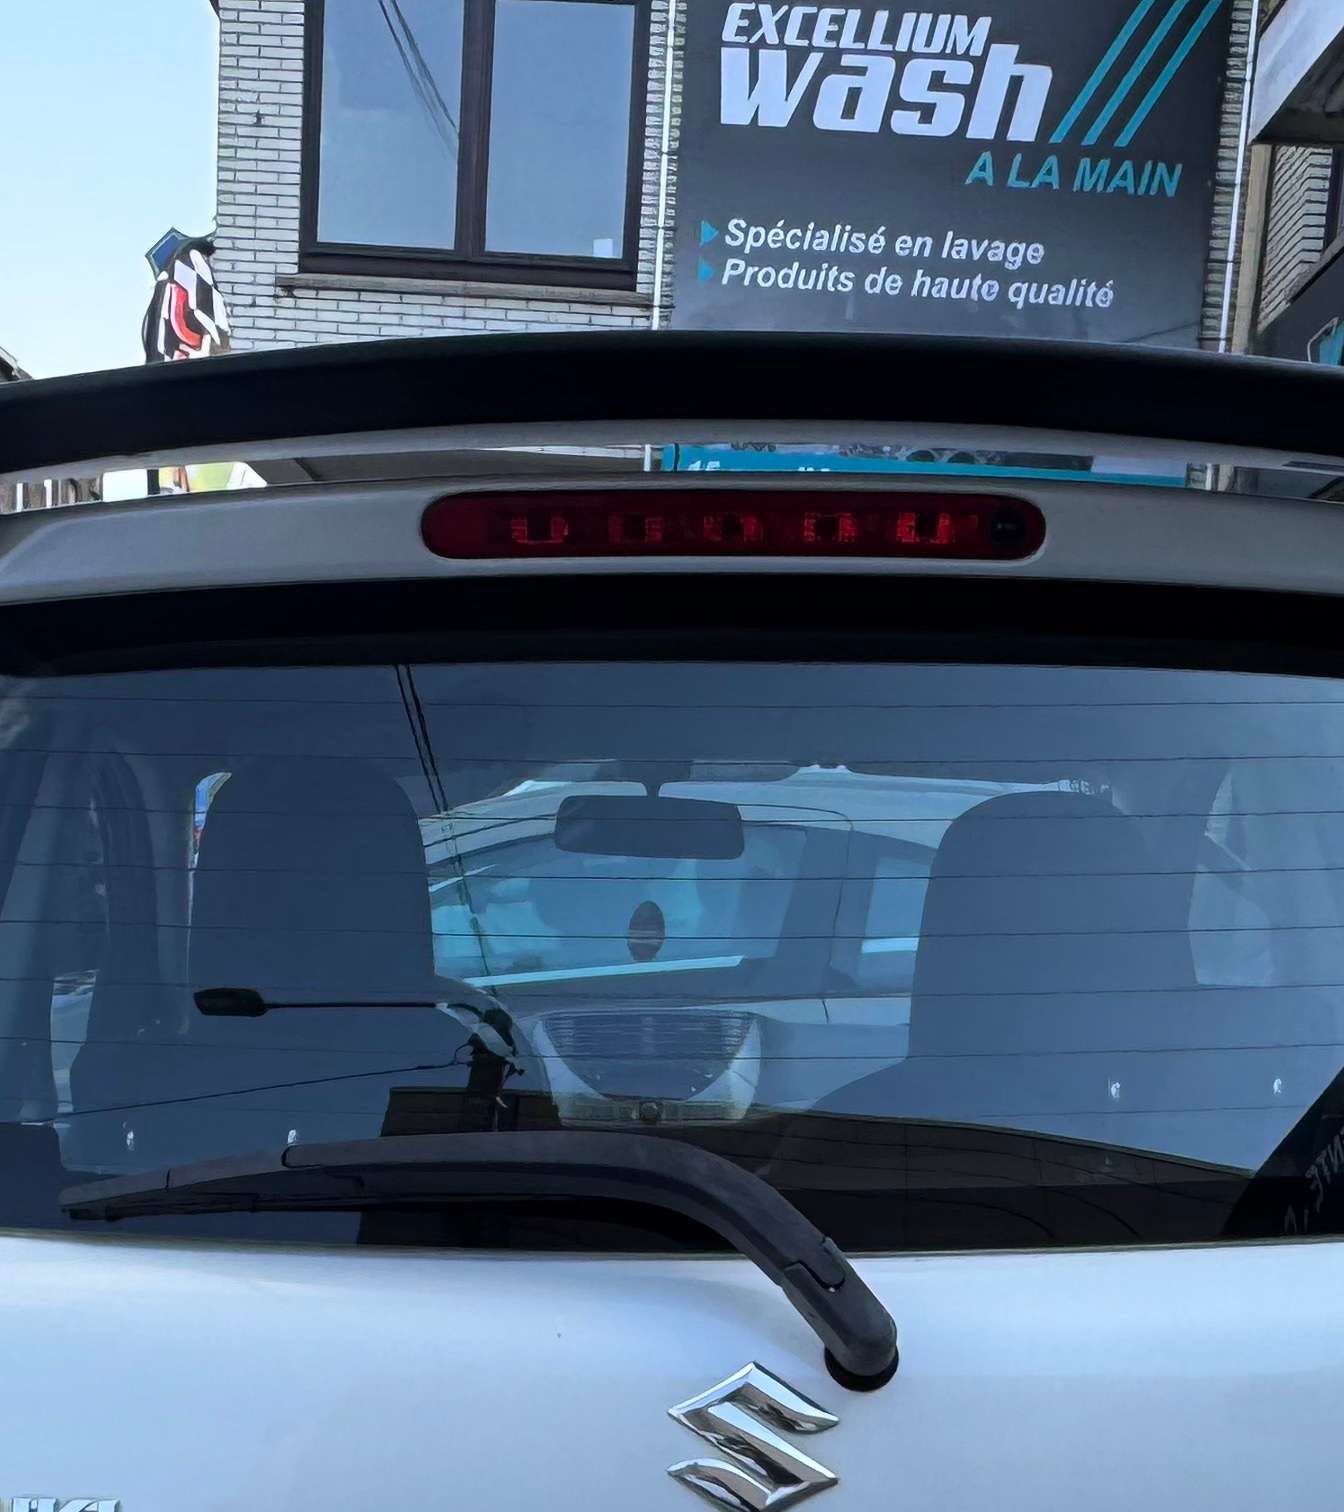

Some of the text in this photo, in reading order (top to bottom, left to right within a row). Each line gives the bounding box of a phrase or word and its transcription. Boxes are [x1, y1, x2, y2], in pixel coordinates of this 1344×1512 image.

[721, 2, 993, 57] EXCELLIUM
[965, 150, 1183, 198] A LA MAIN
[724, 218, 1045, 270] Spécialisé en lavage
[721, 258, 1115, 310] Produits de haute qualité
